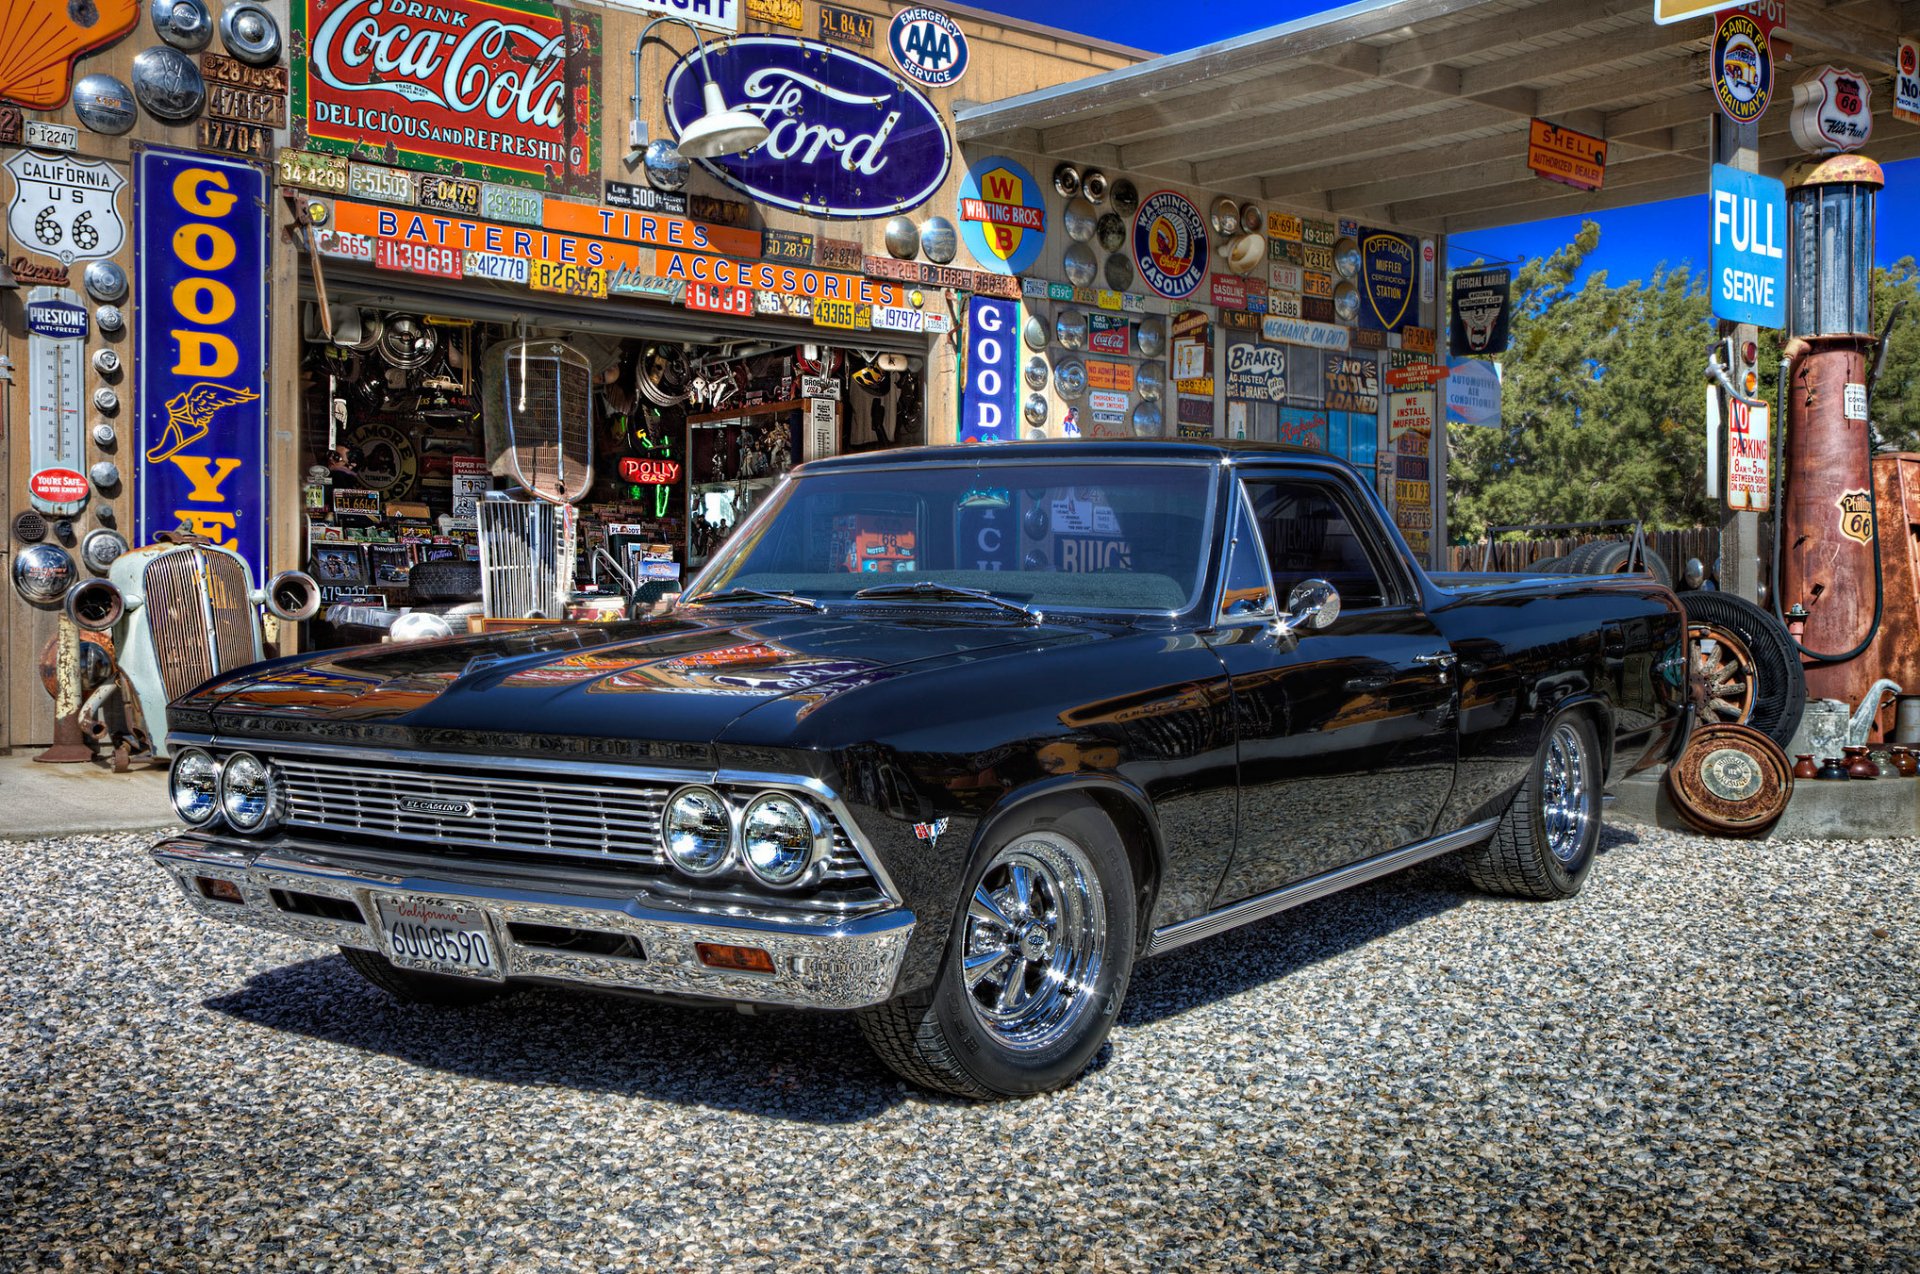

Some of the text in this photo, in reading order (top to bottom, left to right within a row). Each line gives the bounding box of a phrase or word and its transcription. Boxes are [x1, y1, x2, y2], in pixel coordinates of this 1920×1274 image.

[389, 0, 469, 28] DRINK
[900, 8, 960, 39] EMERGENCY
[905, 22, 951, 70] AAA
[1721, 19, 1766, 54] SANTA FE
[313, 0, 569, 128] Coca-Cola
[1903, 50, 1913, 66] 76
[903, 57, 951, 83] SERVICE
[1717, 74, 1767, 116] TRAILWAYS
[1841, 95, 1858, 112] 66
[733, 67, 901, 175] Ford
[40, 129, 75, 146] 12247
[315, 100, 582, 166] DELICIOUS AND REFRESHING
[1542, 129, 1595, 157] SHELL
[22, 161, 111, 188] CALIFORNIA
[1534, 151, 1601, 180] AUTHORIZED DEALER
[437, 180, 477, 206] 0479
[606, 192, 631, 205] Requires
[612, 184, 627, 195] Law
[632, 187, 655, 209] 500
[989, 175, 1015, 200] W
[665, 202, 684, 213] Trucks
[964, 199, 1040, 227] WHITING BROS.
[1138, 194, 1205, 239] WASHINGTON
[35, 205, 99, 250] 66
[599, 210, 709, 248] TIRES
[1714, 189, 1783, 259] FULL
[377, 209, 604, 267] BATTERIES
[994, 227, 1014, 251] B
[387, 241, 453, 274] 113968
[783, 241, 810, 258] 2837
[1368, 239, 1410, 261] OFFICIAL
[477, 254, 525, 281] 412778
[1140, 256, 1201, 294] GASOLINE
[1160, 255, 1191, 275] Chief
[1375, 259, 1402, 274] MUFFLER
[611, 261, 685, 304] Liberty
[667, 254, 894, 304] ACCESSORIES
[1456, 273, 1506, 290] OFFICIAL GARAGE
[1722, 267, 1775, 308] SERVE
[1213, 284, 1244, 298] GASOLINE
[1375, 285, 1402, 299] STATION
[29, 306, 86, 327] PRESTONE
[815, 302, 852, 326] 43365
[885, 308, 921, 330] 197972
[1094, 315, 1106, 323] GAS
[1234, 313, 1258, 328] SMITH
[35, 324, 80, 334] ANTI-FREEZE
[1093, 321, 1109, 330] TODAY
[1264, 320, 1347, 346] MECHANIC ON DUTY
[1230, 346, 1283, 371] BRAKES
[1342, 359, 1361, 374] NO
[1088, 366, 1131, 378] NO ADMITTANCE
[1228, 372, 1269, 386] ADJUSTED!
[1325, 372, 1378, 396] TOOLS
[1325, 391, 1378, 413] LOANED
[1397, 407, 1426, 417] INSTALL
[1405, 396, 1417, 406] WE
[1392, 417, 1431, 429] MUFFLERS
[1731, 401, 1748, 430] NO
[1731, 437, 1767, 460] PARKING
[455, 461, 475, 469] SUPER
[627, 459, 680, 479] POLLY
[1734, 458, 1758, 474] 8 5
[640, 473, 665, 483] GAS
[1731, 473, 1767, 485] BETWEEN SIGNS
[1731, 482, 1738, 491] ON
[1757, 485, 1767, 494] DAYS
[61, 486, 77, 494] KNOW
[1850, 514, 1871, 537] 66
[866, 546, 911, 556] MOTOR OIL
[882, 534, 897, 547] 66
[406, 800, 463, 812] EL CAMINO
[408, 895, 444, 906] 1966
[397, 902, 467, 925] California
[392, 921, 490, 967] 6U08590
